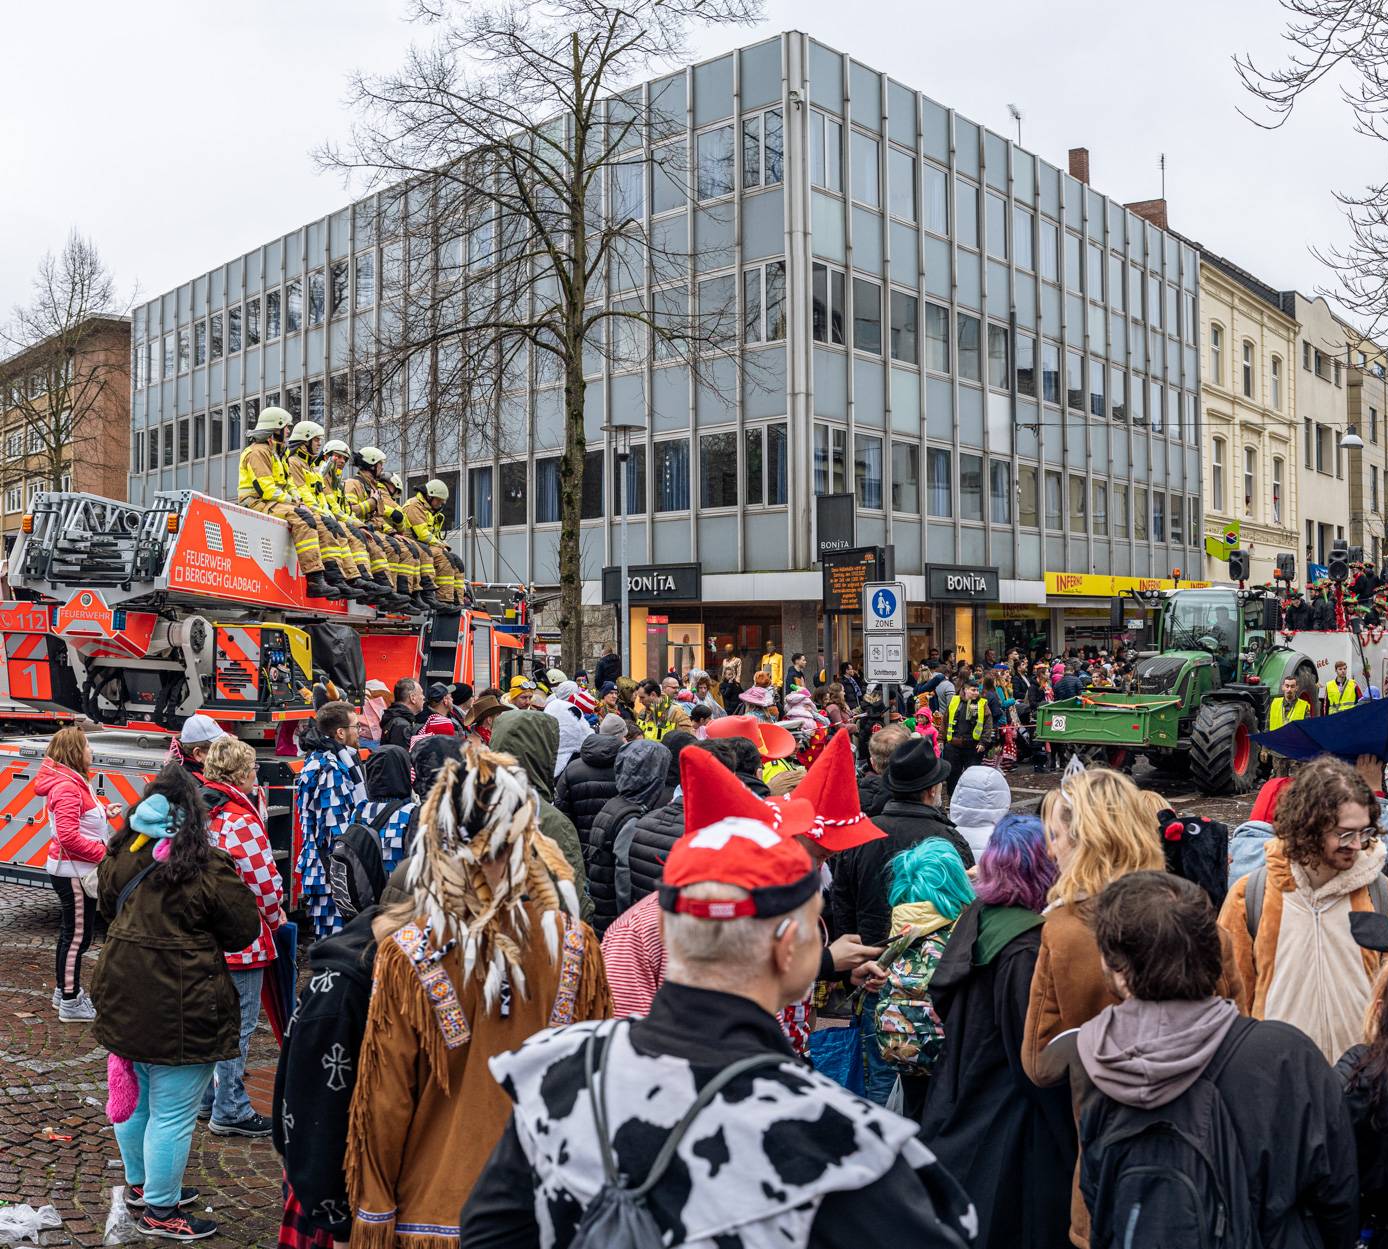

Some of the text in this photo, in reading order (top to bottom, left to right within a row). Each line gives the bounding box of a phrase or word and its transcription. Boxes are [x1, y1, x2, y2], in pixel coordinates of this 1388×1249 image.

[186, 550, 232, 572] FEUERWEHR
[185, 571, 261, 593] BERGISCH GLADBACH
[946, 572, 987, 595] BONITA
[1056, 575, 1083, 593] INFERNO
[17, 613, 45, 629] 112
[60, 610, 111, 620] FEUERWEHR
[875, 620, 894, 628] ZONE
[22, 663, 39, 697] 1
[1054, 719, 1064, 728] 20
